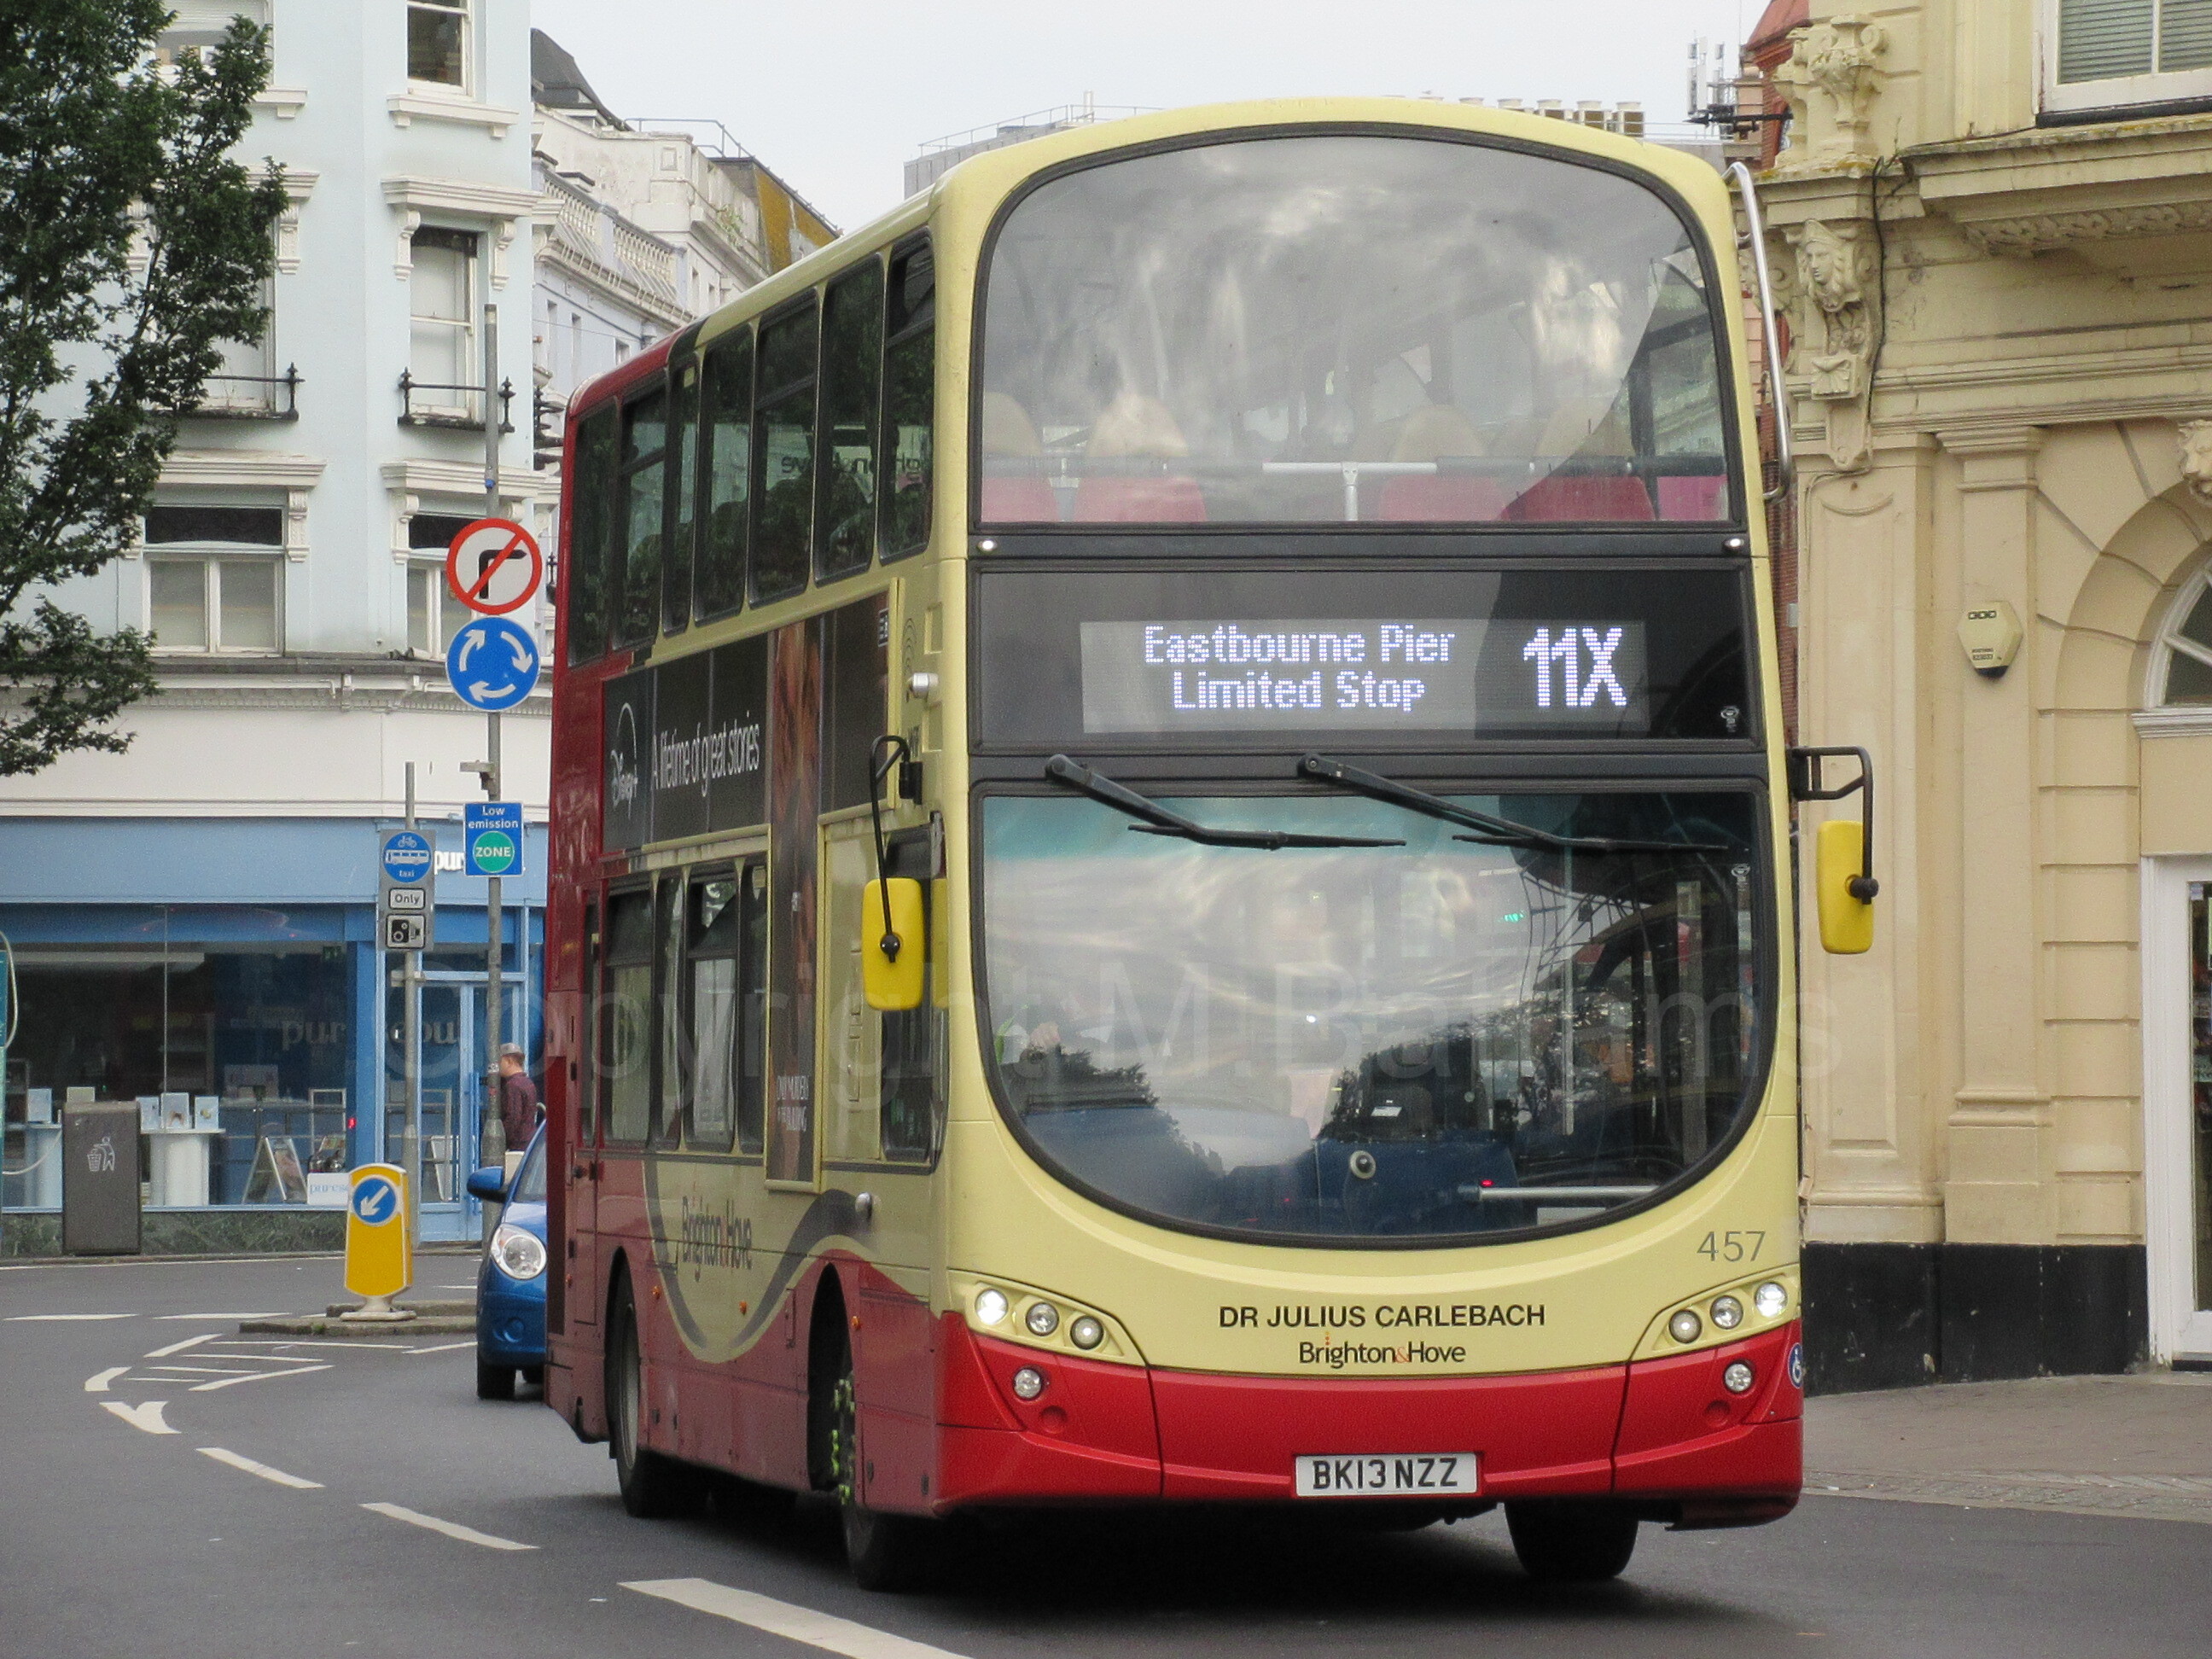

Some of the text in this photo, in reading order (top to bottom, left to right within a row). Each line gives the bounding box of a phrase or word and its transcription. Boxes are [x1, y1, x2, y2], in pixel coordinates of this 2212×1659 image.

[1144, 624, 1456, 663] Eastbourne Pier
[1522, 627, 1627, 707] 11X
[1173, 670, 1426, 712] Limited Stop
[649, 710, 760, 798] A lifetime of great stories
[469, 819, 518, 829] emission
[482, 806, 505, 816] Low
[475, 847, 511, 858] ZONE
[394, 893, 420, 905] Only
[1697, 1231, 1766, 1262] 457
[1219, 1304, 1545, 1329] DR JULIUS CARLEBACH
[1313, 1456, 1458, 1491] BK13 NZZ
